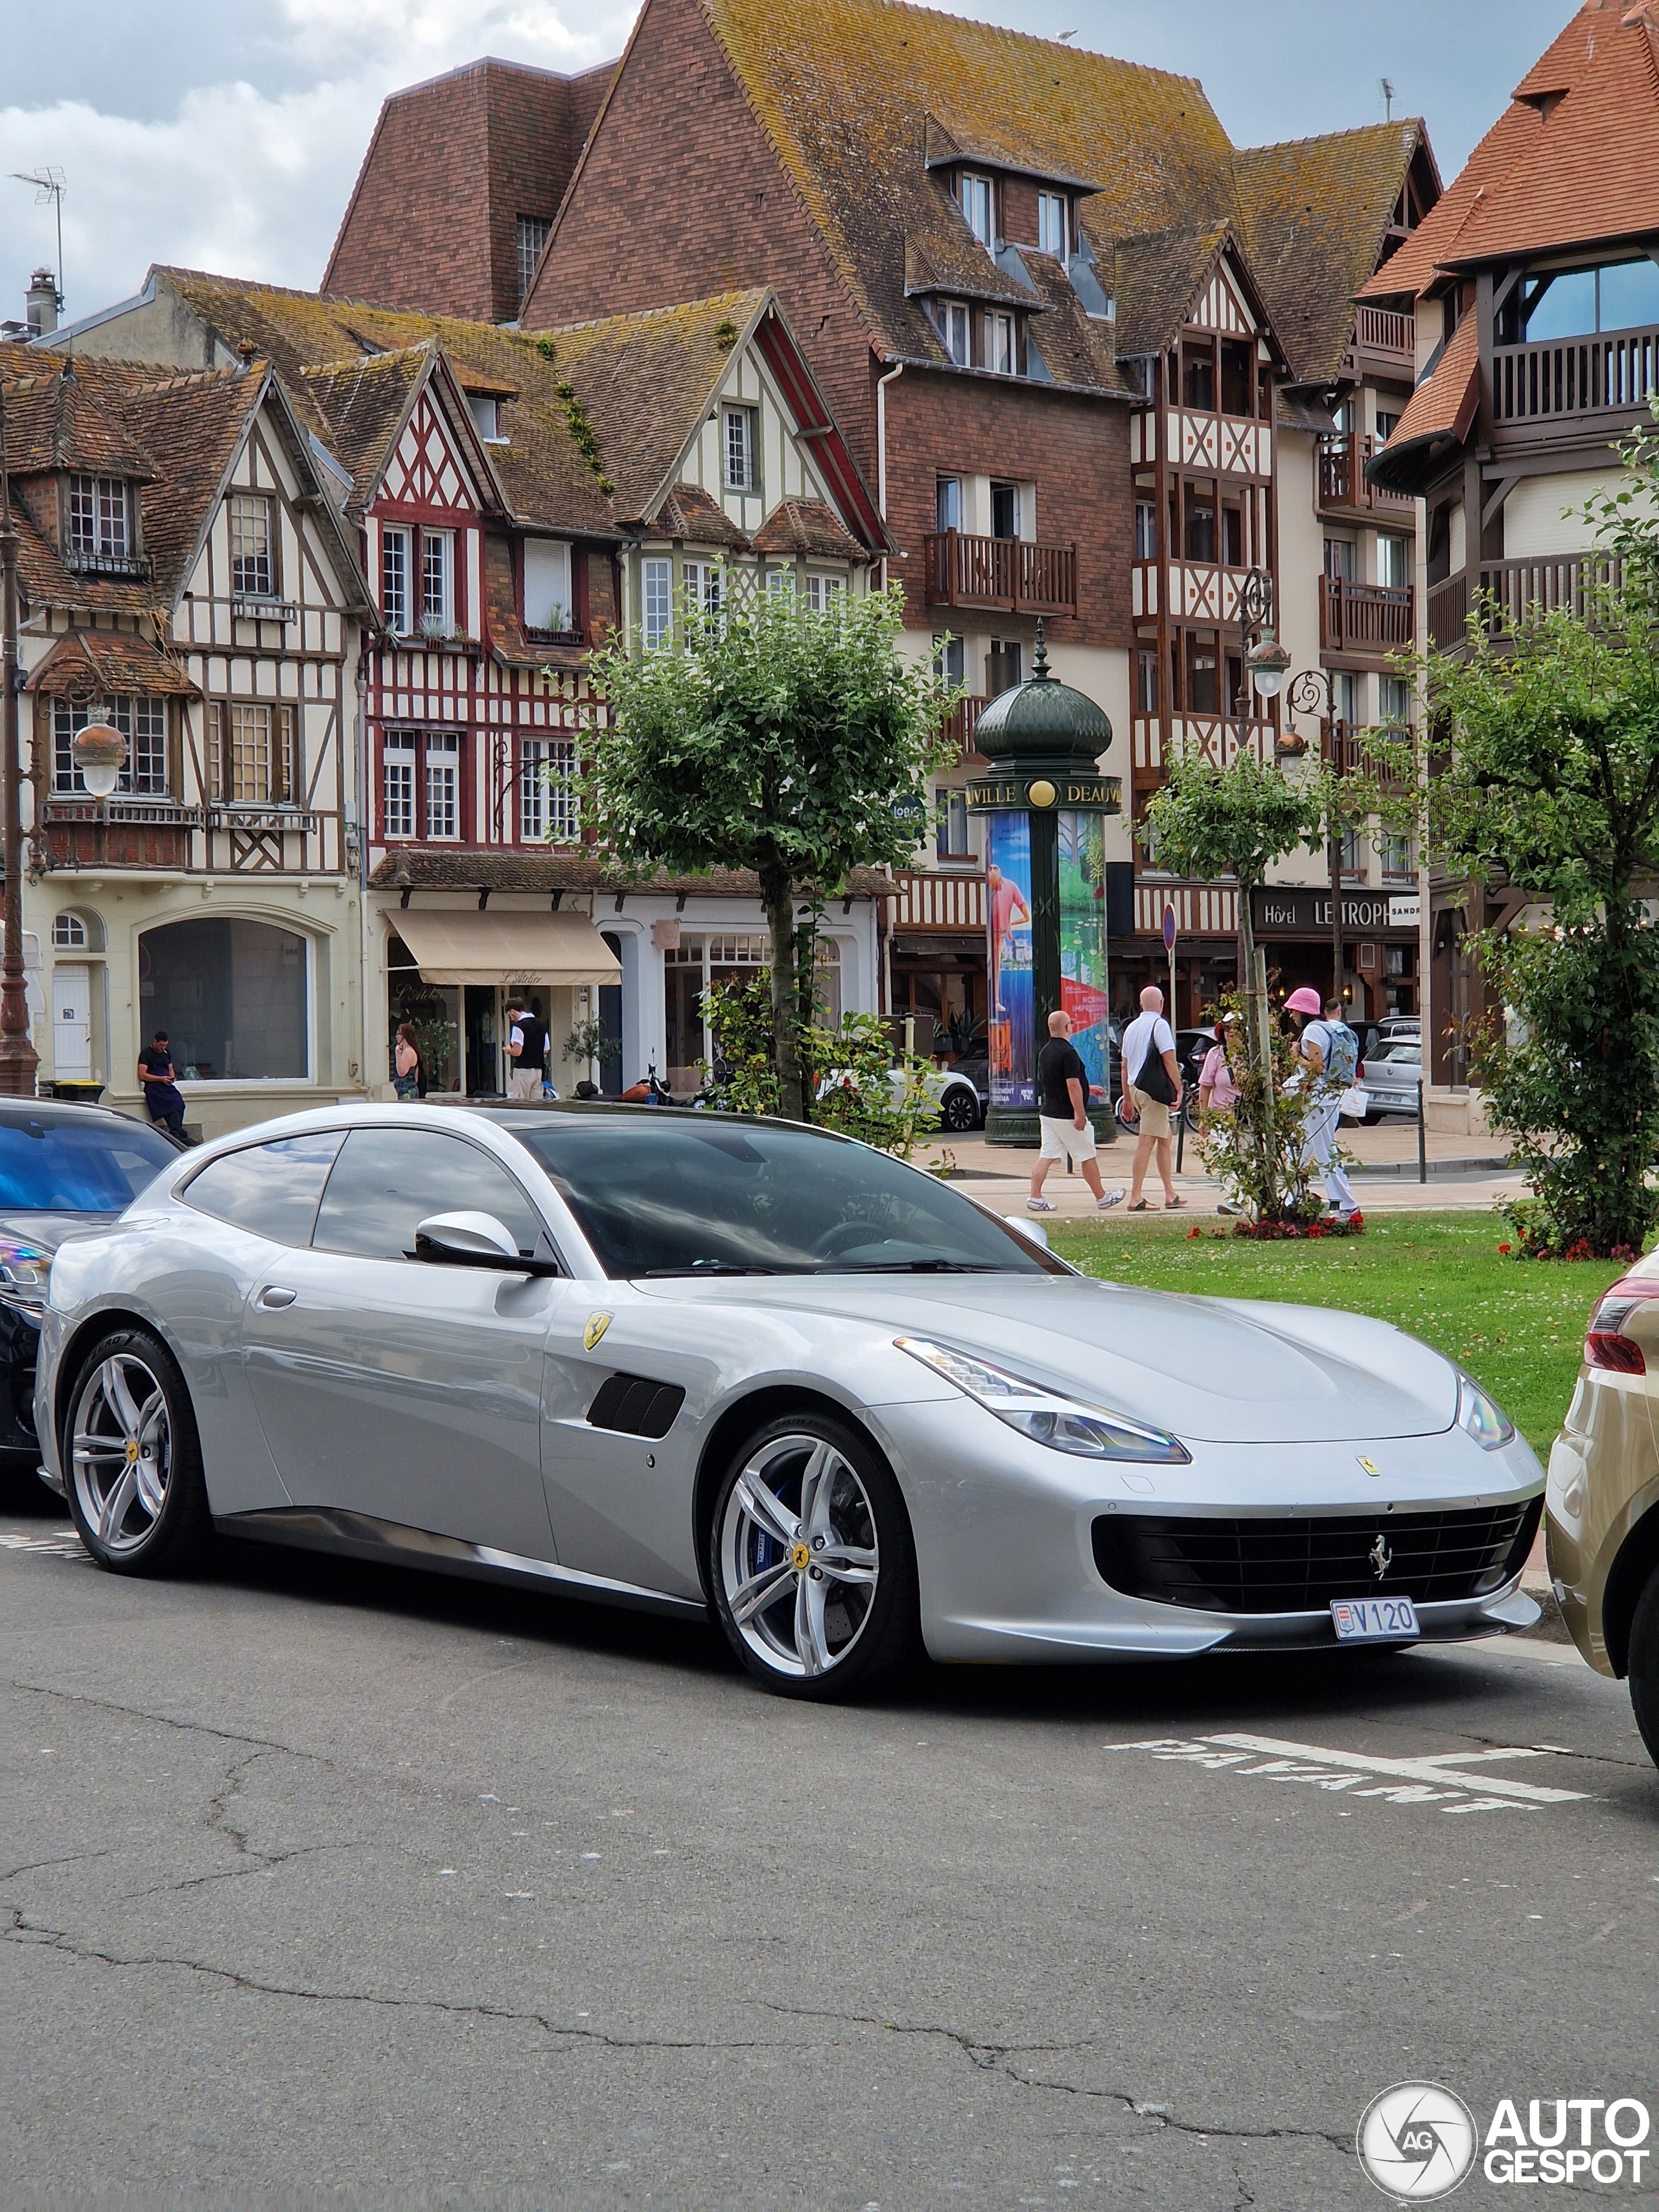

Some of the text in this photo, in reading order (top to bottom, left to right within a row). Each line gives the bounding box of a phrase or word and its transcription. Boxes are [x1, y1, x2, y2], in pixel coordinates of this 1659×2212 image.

[1315, 901, 1334, 925] LE
[1353, 1602, 1413, 1633] V120
[1102, 1738, 1544, 1813] PAYANT
